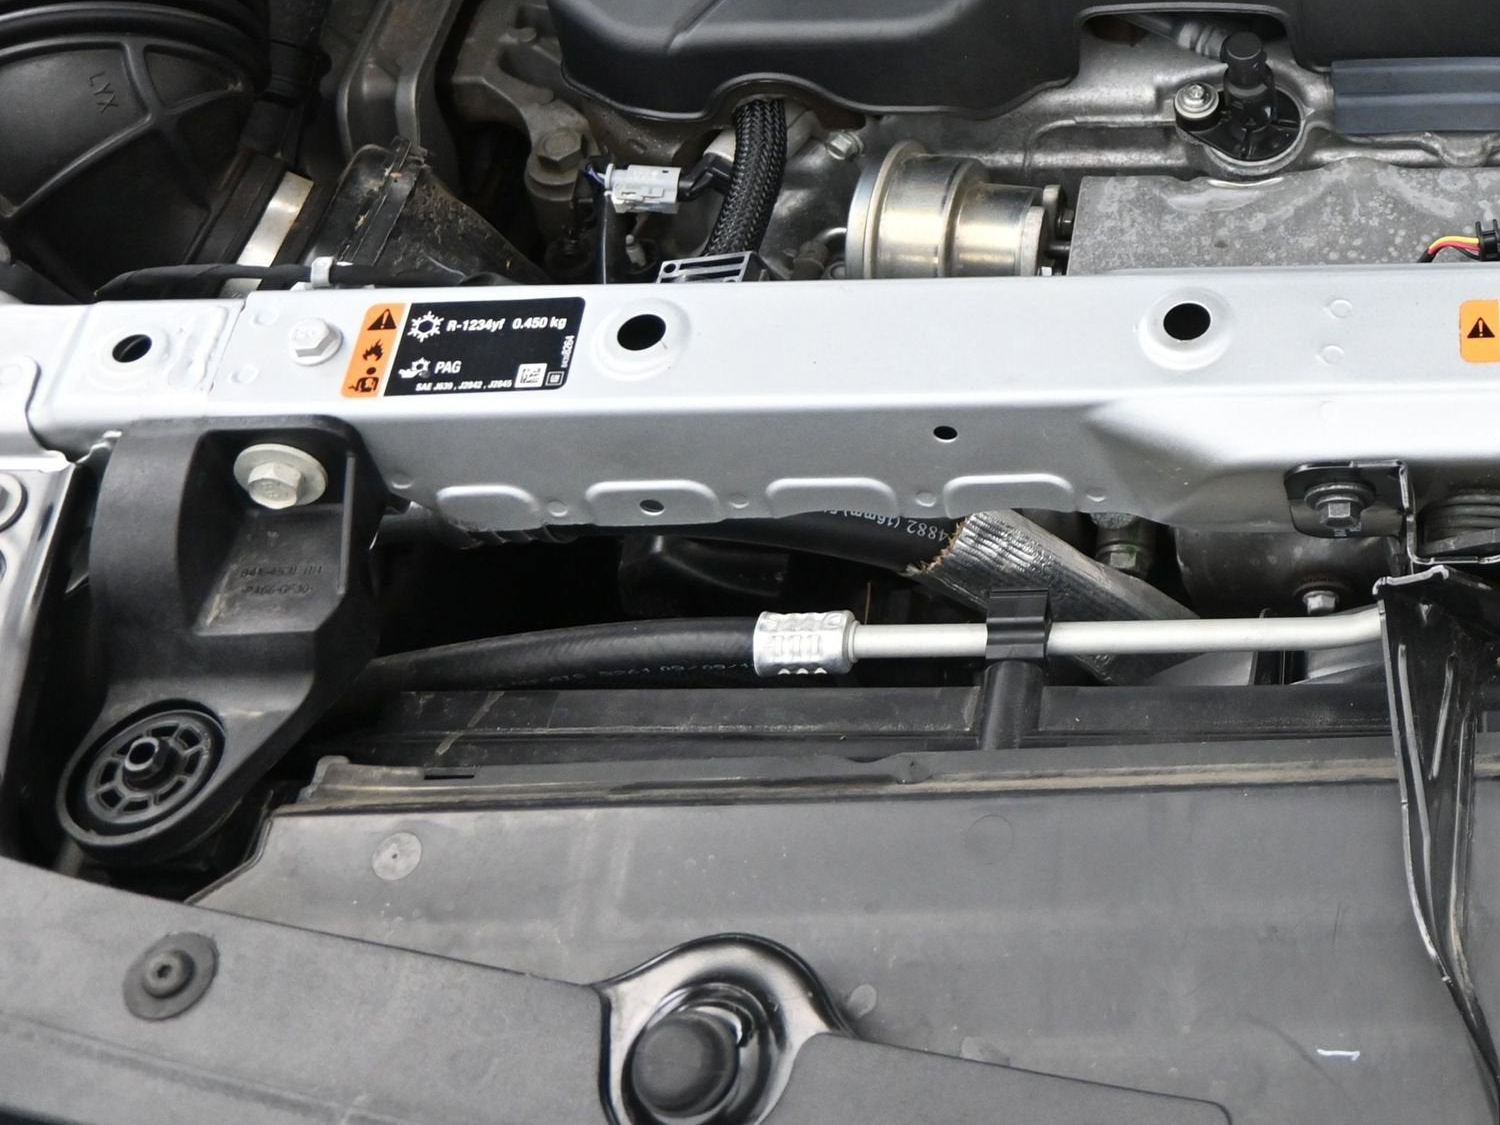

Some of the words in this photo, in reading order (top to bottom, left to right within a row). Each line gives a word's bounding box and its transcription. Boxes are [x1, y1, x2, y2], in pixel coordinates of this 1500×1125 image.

[446, 318, 506, 332] R-1234yf
[512, 316, 548, 329] 0.450
[549, 316, 567, 330] kg
[434, 360, 462, 374] PAG
[415, 382, 433, 391] SAE
